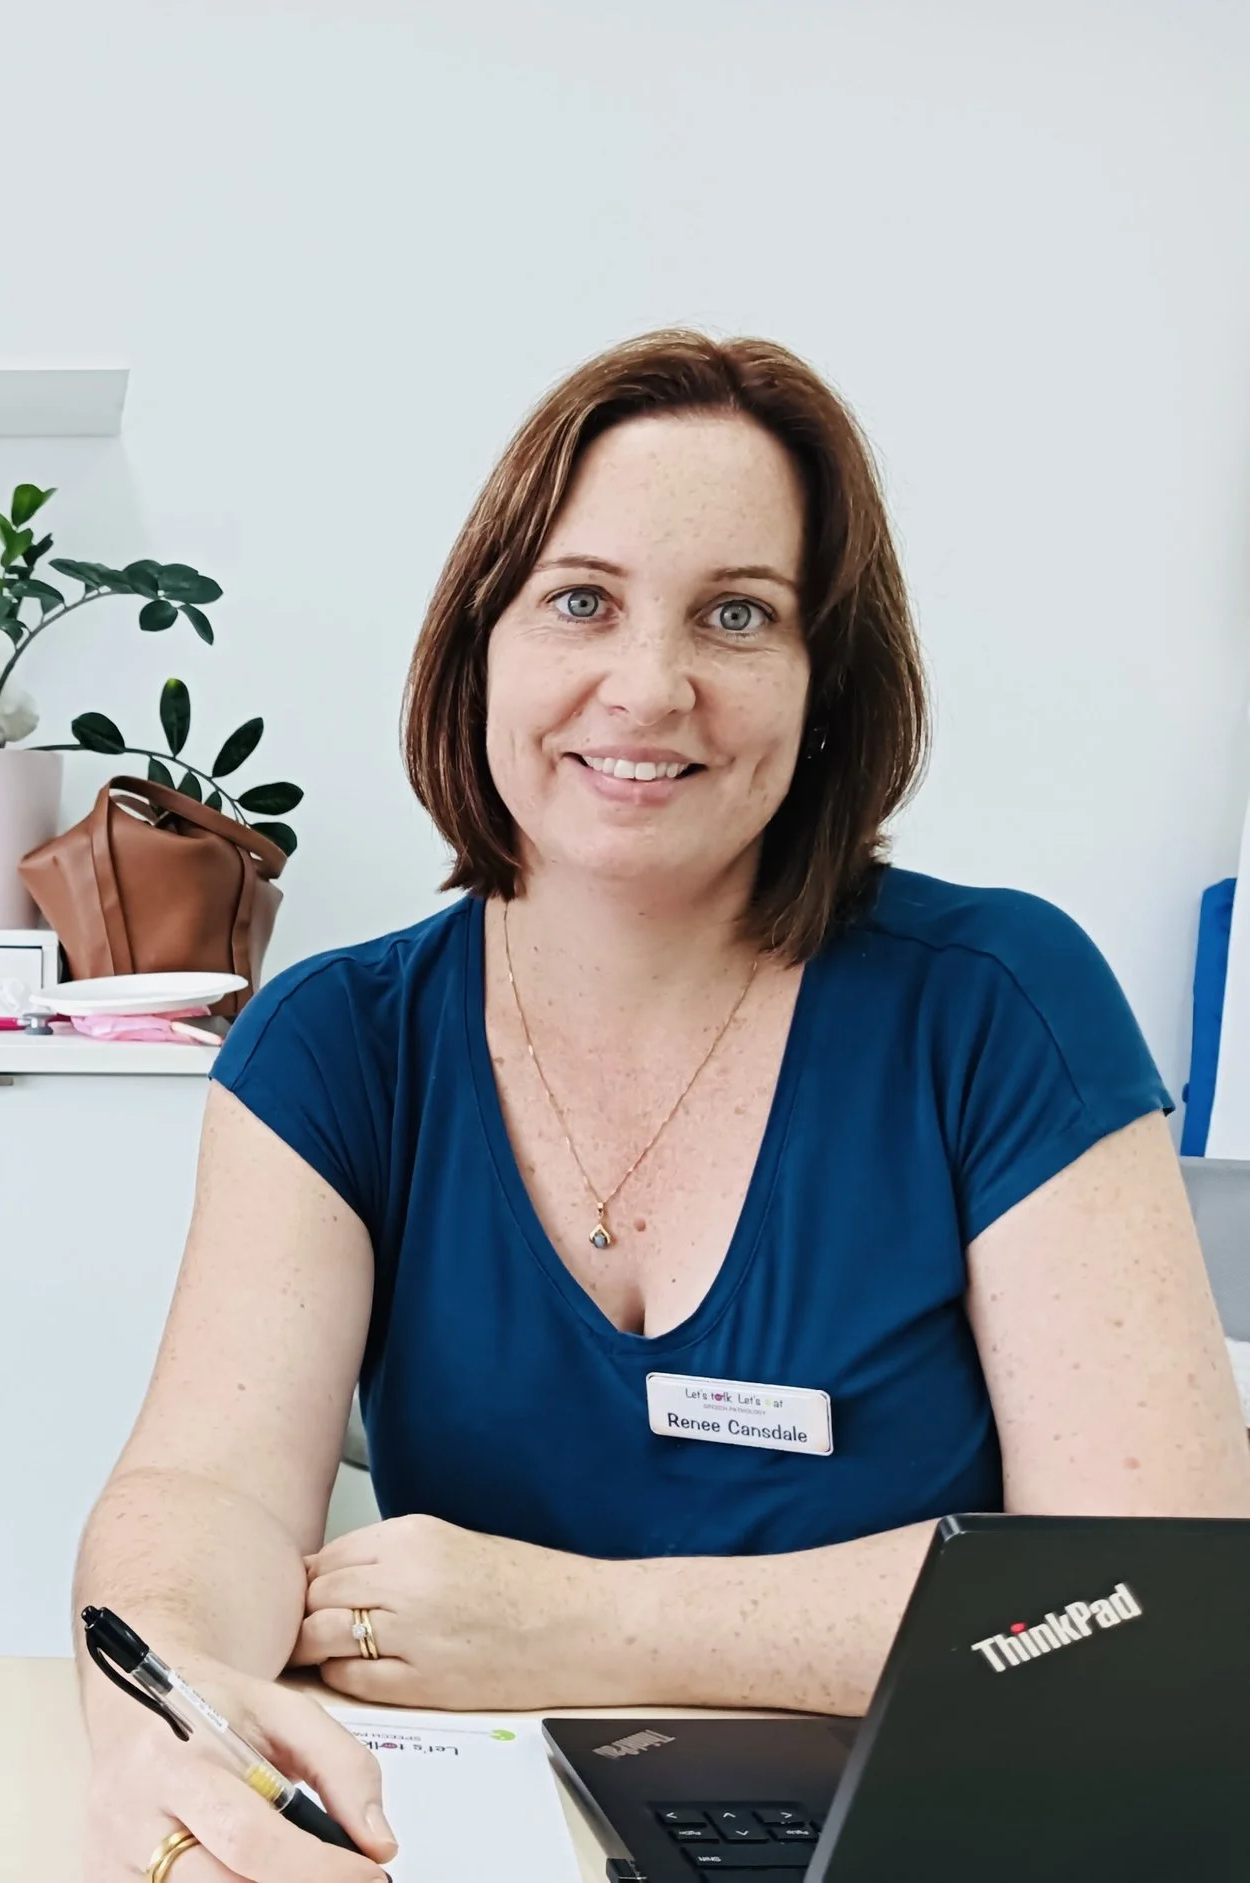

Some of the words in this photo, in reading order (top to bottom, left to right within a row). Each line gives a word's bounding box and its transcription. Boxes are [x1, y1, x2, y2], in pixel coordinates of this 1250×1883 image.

[685, 1388, 708, 1400] Let's
[738, 1393, 761, 1406] Let's
[667, 1412, 721, 1433] Renee
[728, 1419, 808, 1443] Cansdale
[971, 1582, 1143, 1673] ThinkPad
[412, 1743, 458, 1756] Let's
